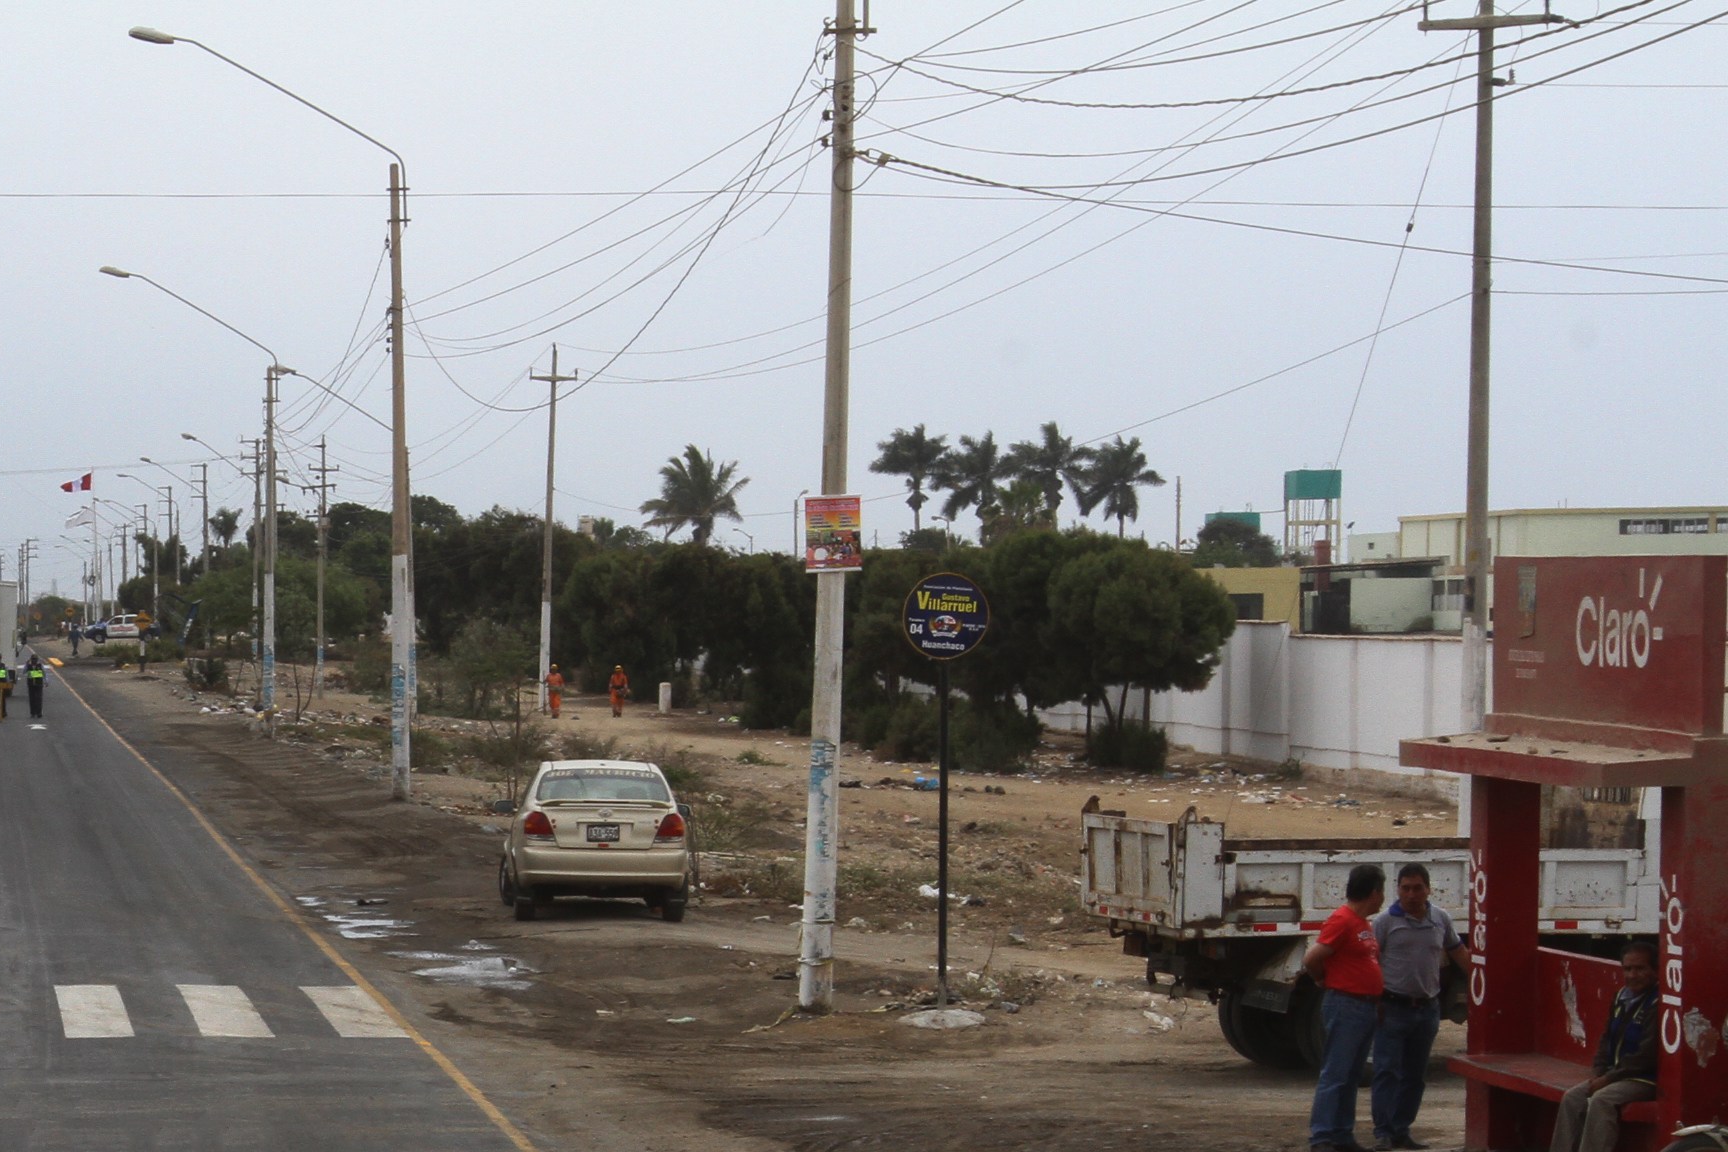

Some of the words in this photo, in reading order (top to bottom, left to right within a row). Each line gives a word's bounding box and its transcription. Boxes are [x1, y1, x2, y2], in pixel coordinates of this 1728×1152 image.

[917, 590, 978, 613] Villarruel
[942, 593, 970, 602] Gustavo
[909, 623, 923, 634] 04
[1576, 596, 1650, 668] Claro
[922, 640, 965, 650] Huanchaco
[1471, 870, 1488, 1006] Claro
[1661, 897, 1684, 1054] Claro
